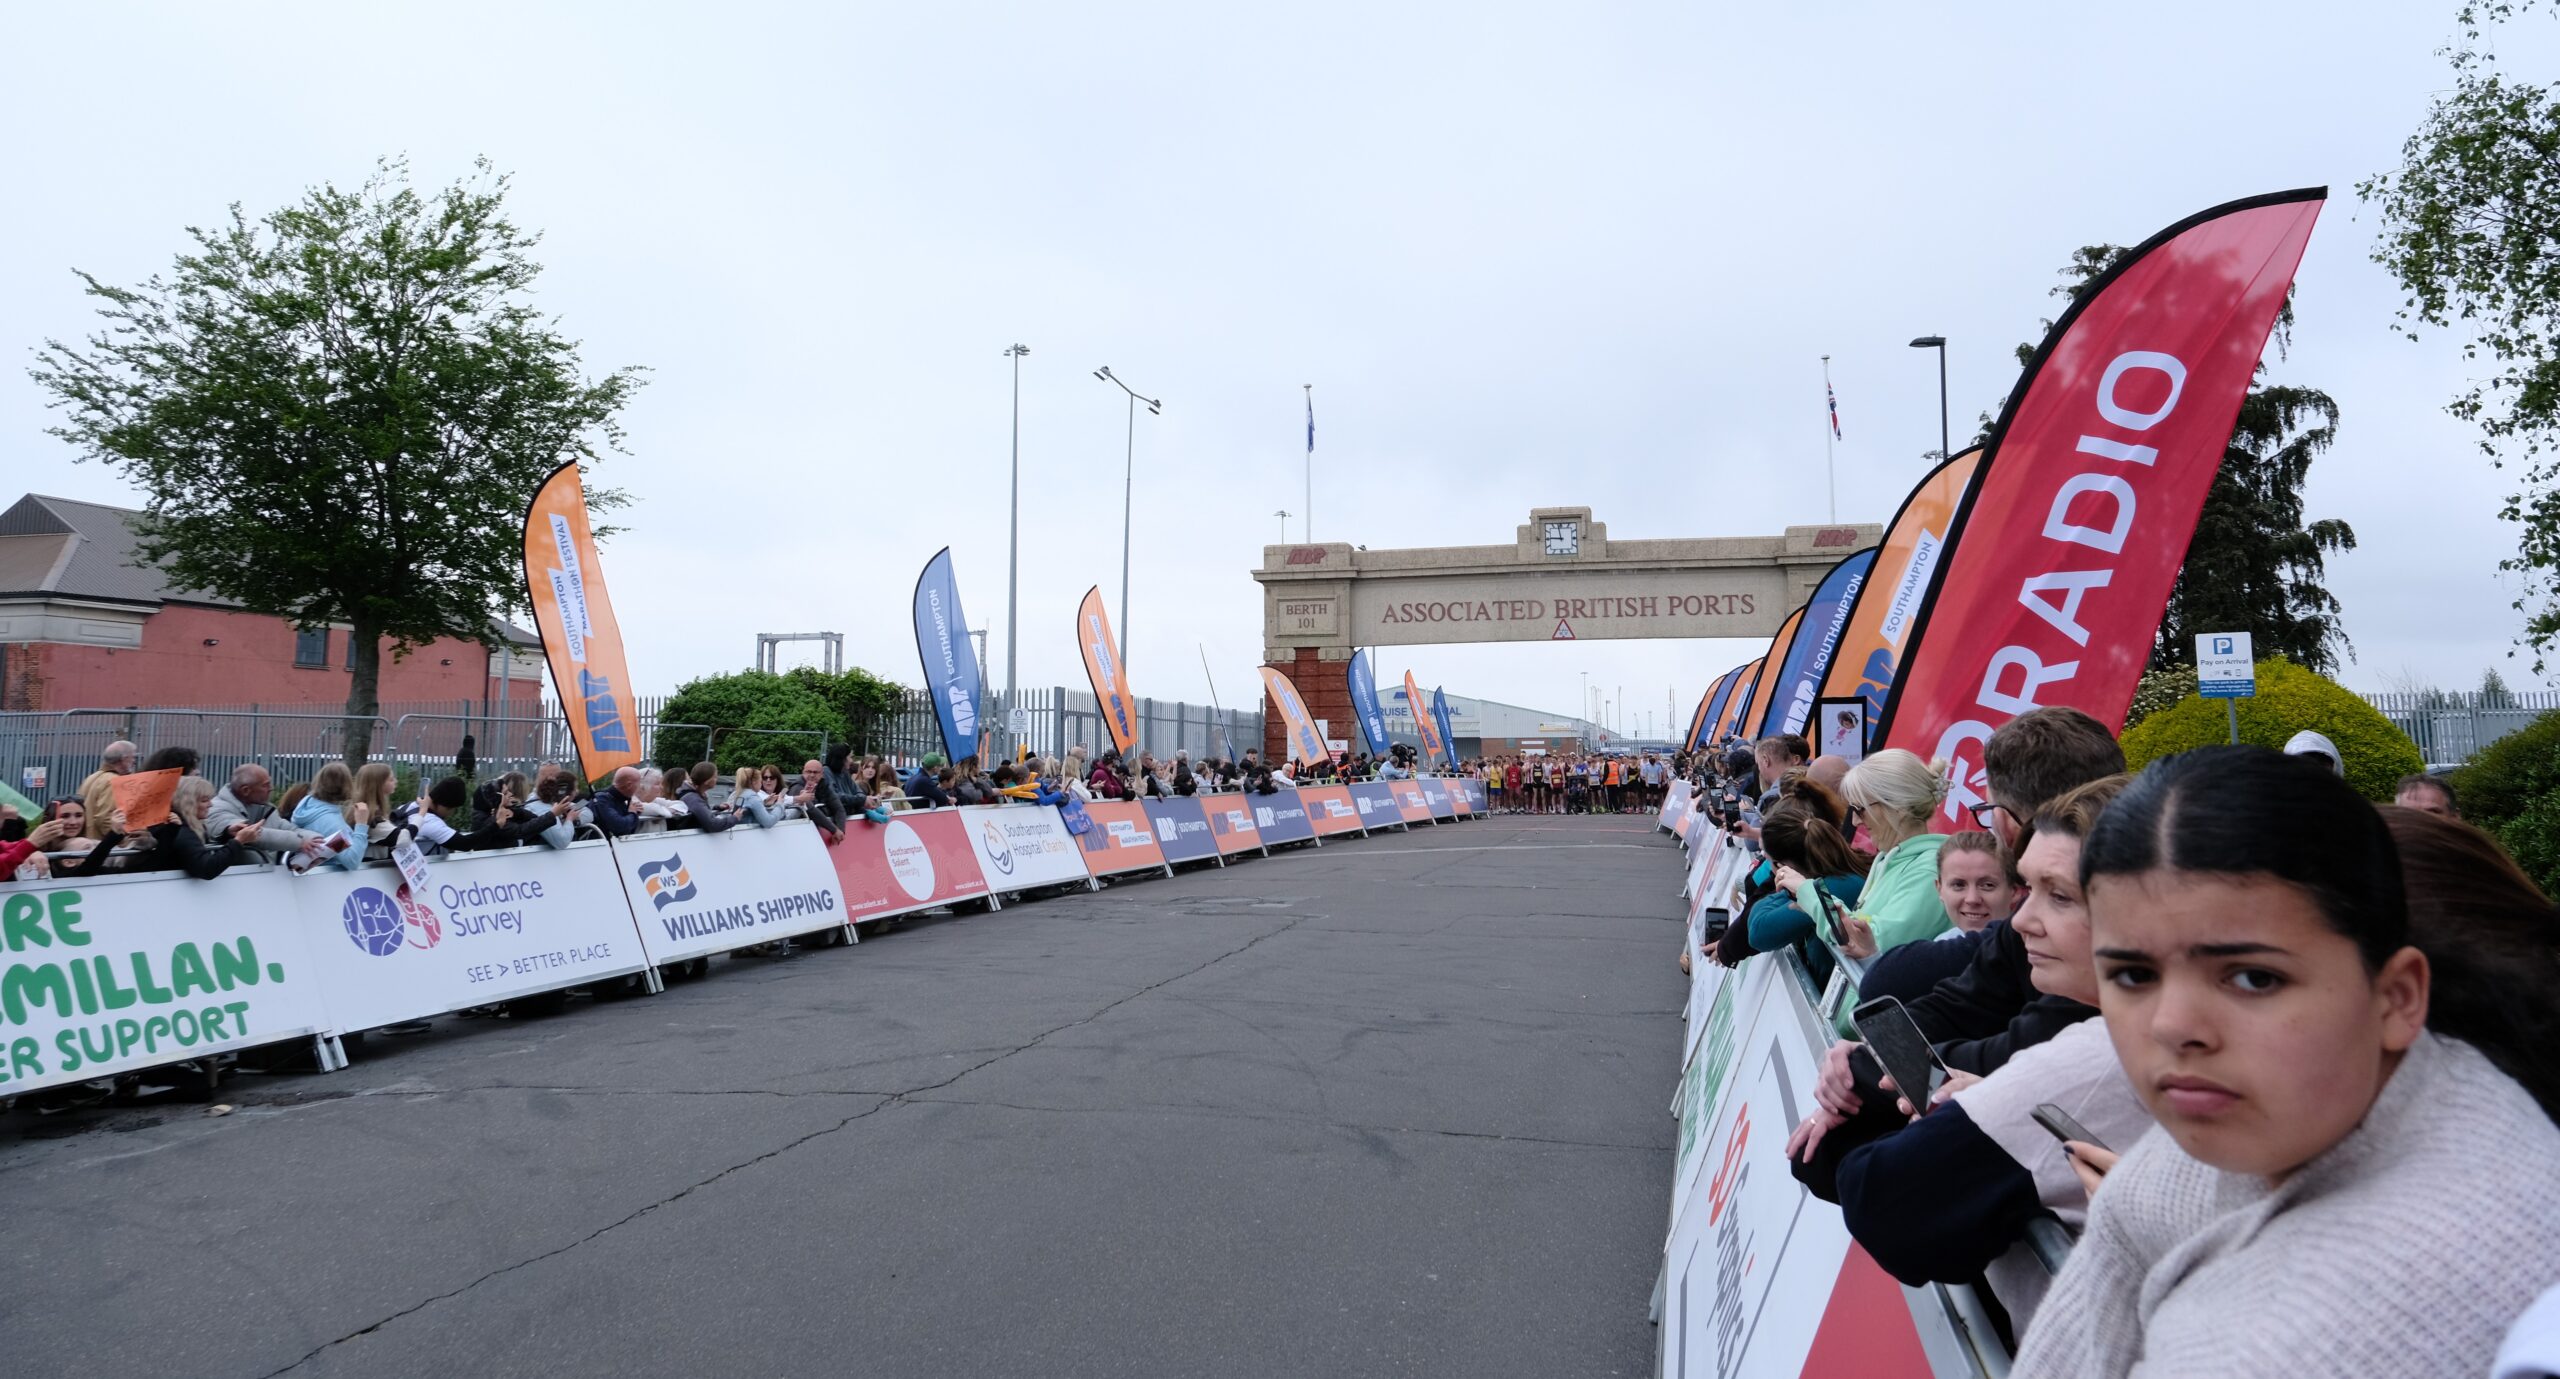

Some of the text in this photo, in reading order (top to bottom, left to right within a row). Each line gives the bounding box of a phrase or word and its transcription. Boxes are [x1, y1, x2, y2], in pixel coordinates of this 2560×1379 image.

[555, 520, 575, 568] FESTIVAL
[1976, 351, 2187, 716] RADIO
[1887, 541, 1932, 633] SOUTHAMPTON
[554, 576, 583, 656] SOUTHAMPTON
[1286, 604, 1327, 616] BERTH
[1298, 618, 1316, 629] 101
[1381, 594, 1755, 624] ASSOCIATED BRITISH PORTS
[1813, 573, 1864, 672] SOUTHAMPTON
[1003, 823, 1053, 838] Southampton
[1012, 841, 1043, 858] Hospital
[888, 846, 923, 856] Southampton
[439, 880, 544, 910] Ordnance
[660, 875, 677, 888] WS
[0, 890, 92, 952] RE
[450, 909, 522, 937] Survey
[662, 889, 834, 941] WILLIAMS SHIPPING
[0, 935, 285, 1027] MILLAN.
[467, 964, 494, 983] SEE
[513, 951, 568, 975] BETTER
[570, 943, 612, 964] PLACE
[55, 1001, 249, 1072] SUPPORT
